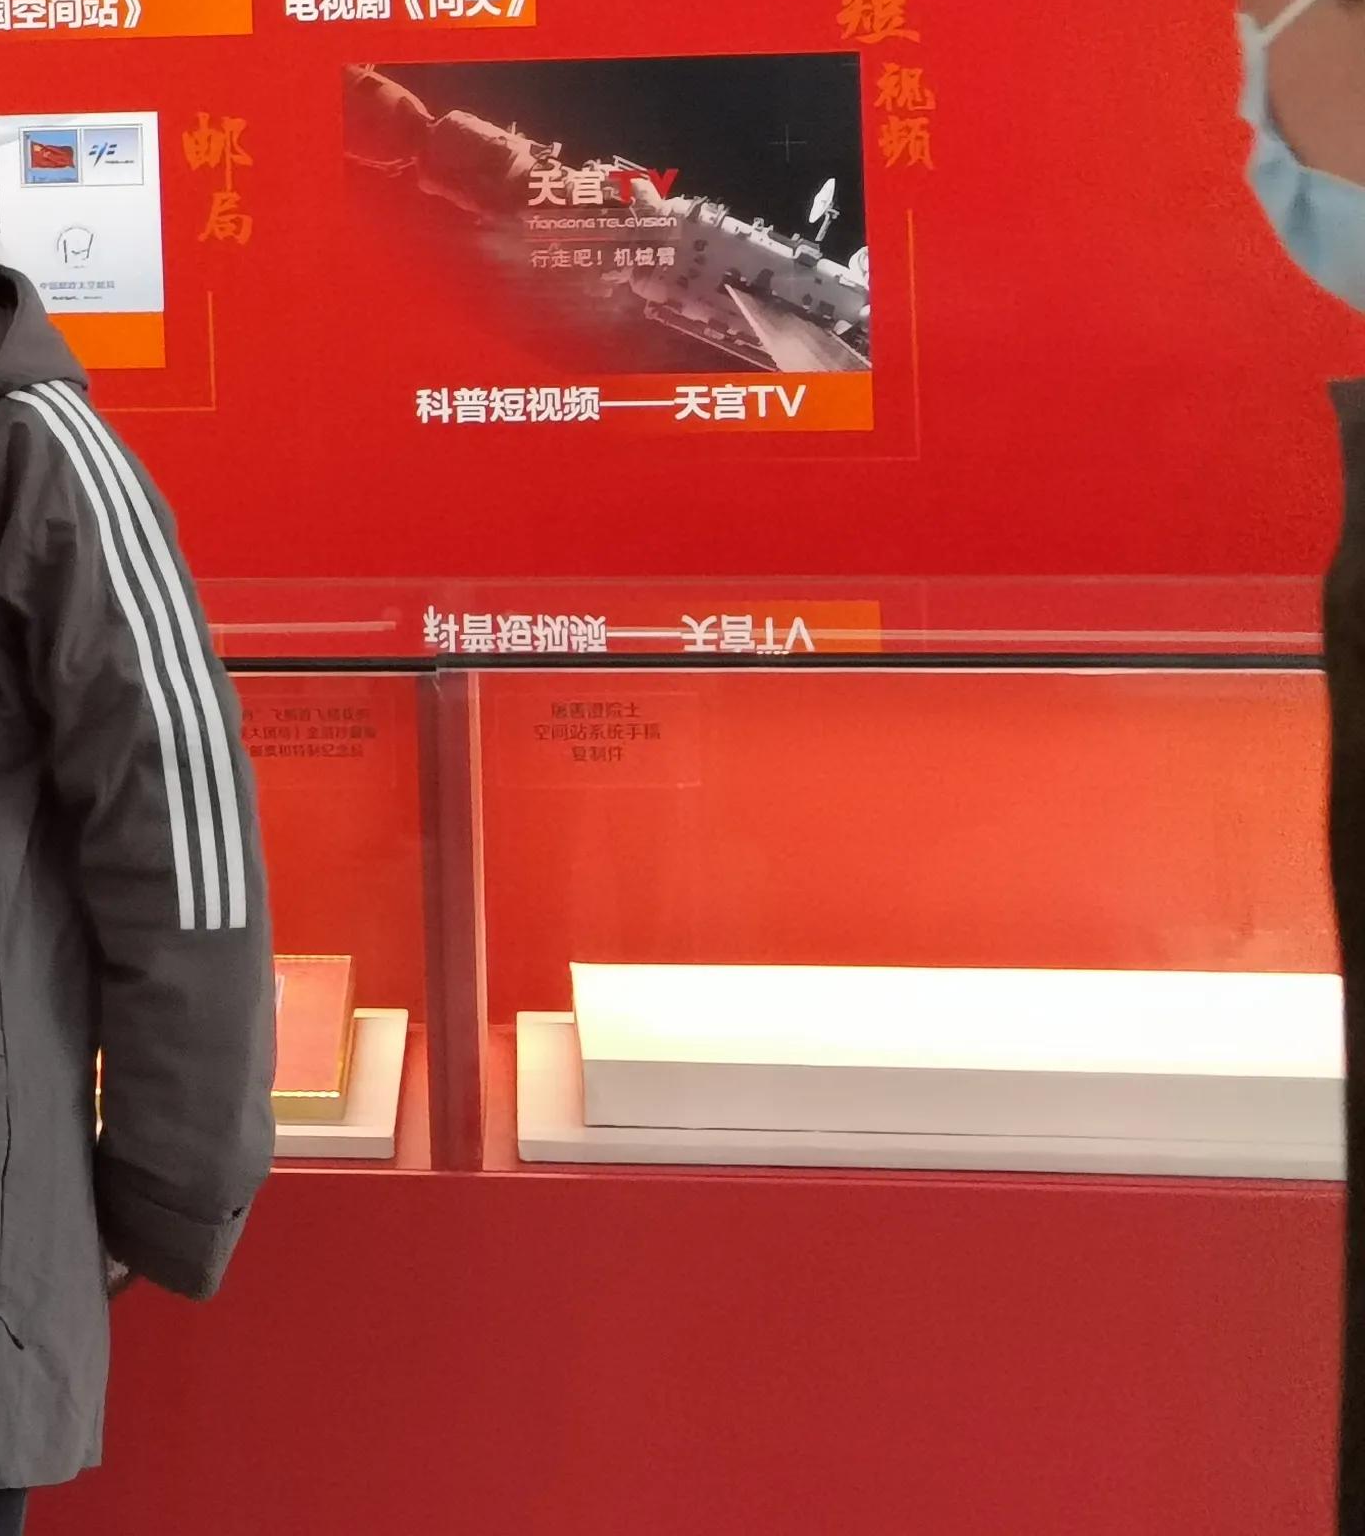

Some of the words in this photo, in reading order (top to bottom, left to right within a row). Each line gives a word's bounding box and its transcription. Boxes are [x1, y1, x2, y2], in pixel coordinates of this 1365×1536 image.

[182, 112, 254, 246] 邮局
[415, 383, 808, 425] 科普短视频——天宫TV
